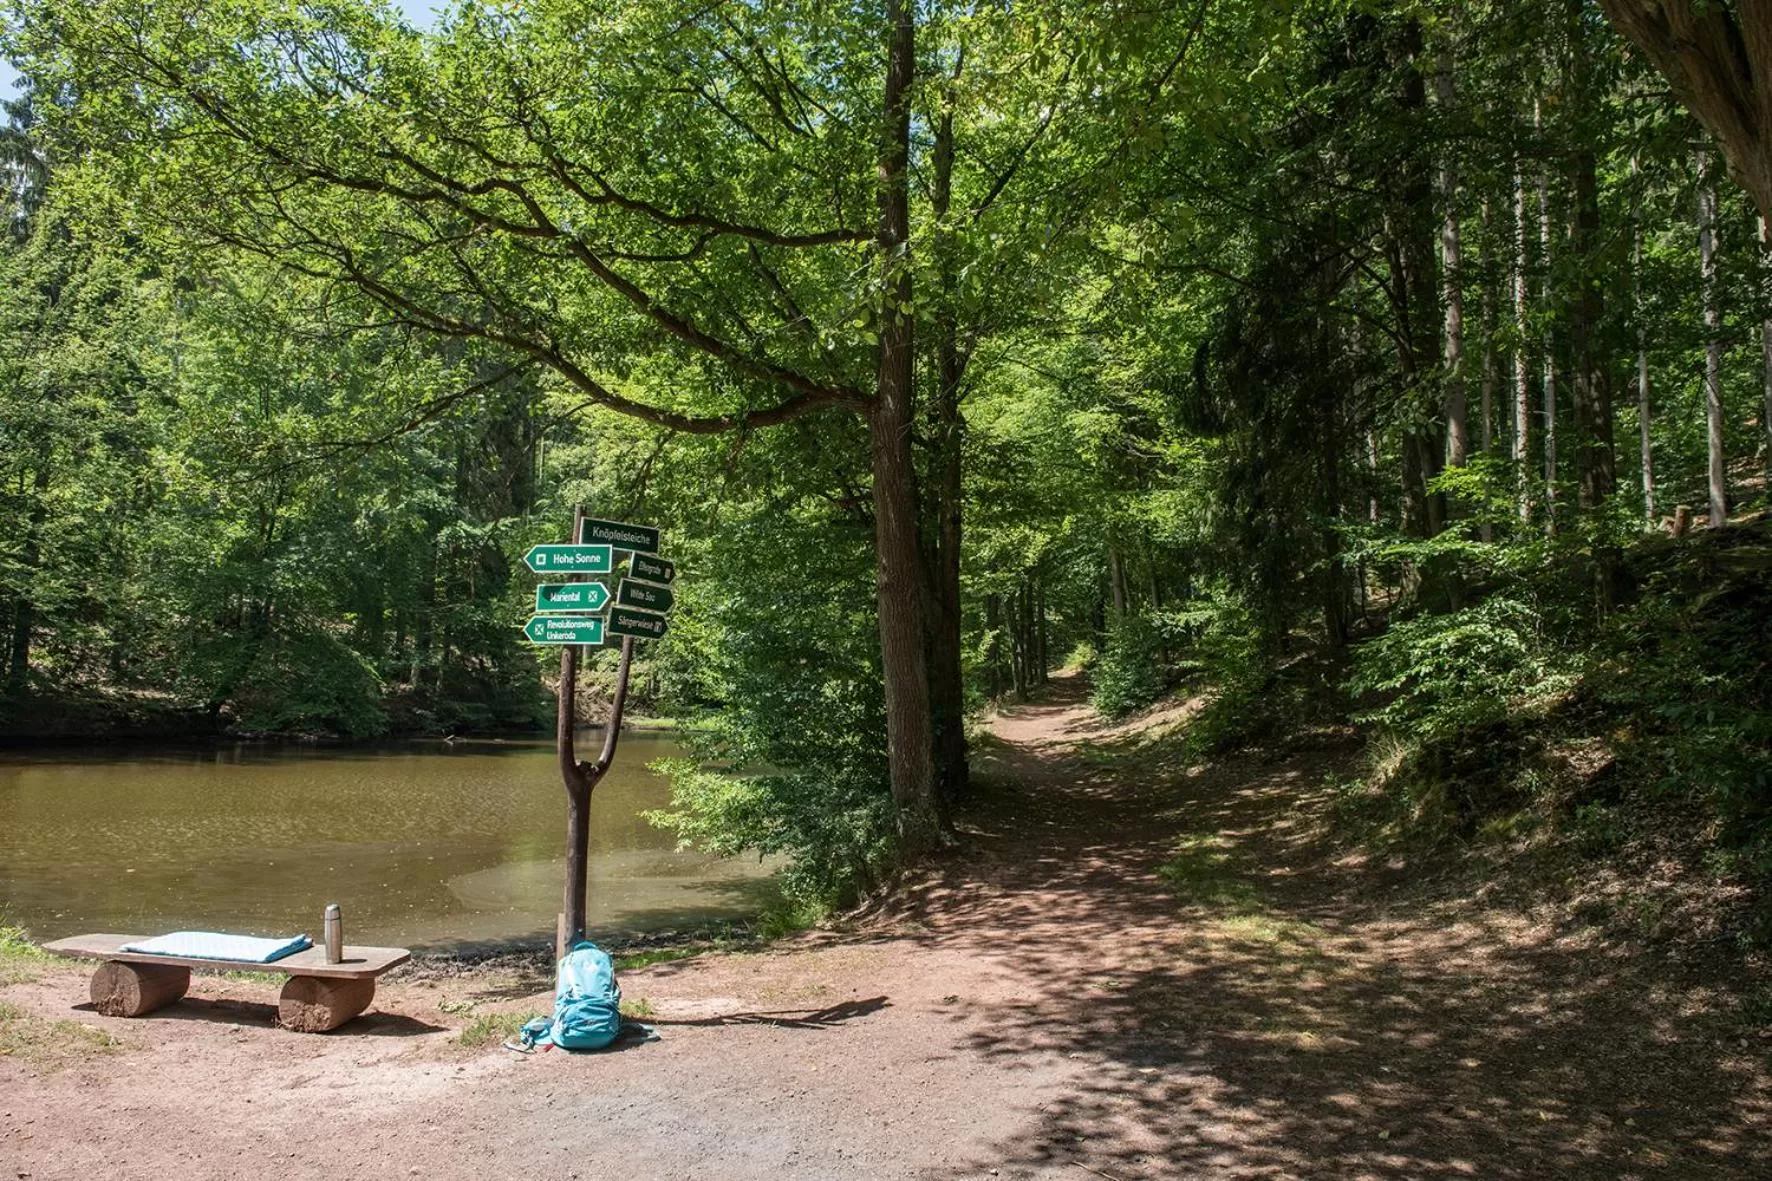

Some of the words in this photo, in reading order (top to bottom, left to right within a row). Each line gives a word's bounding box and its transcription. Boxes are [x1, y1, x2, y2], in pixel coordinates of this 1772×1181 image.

[592, 526, 651, 544] Knöpfelsteiche
[553, 553, 574, 565] Hohe
[575, 553, 601, 563] Sonne
[550, 591, 581, 602] Mariental
[547, 619, 595, 631] Revolutionsweg
[546, 631, 576, 640] Unkeroda
